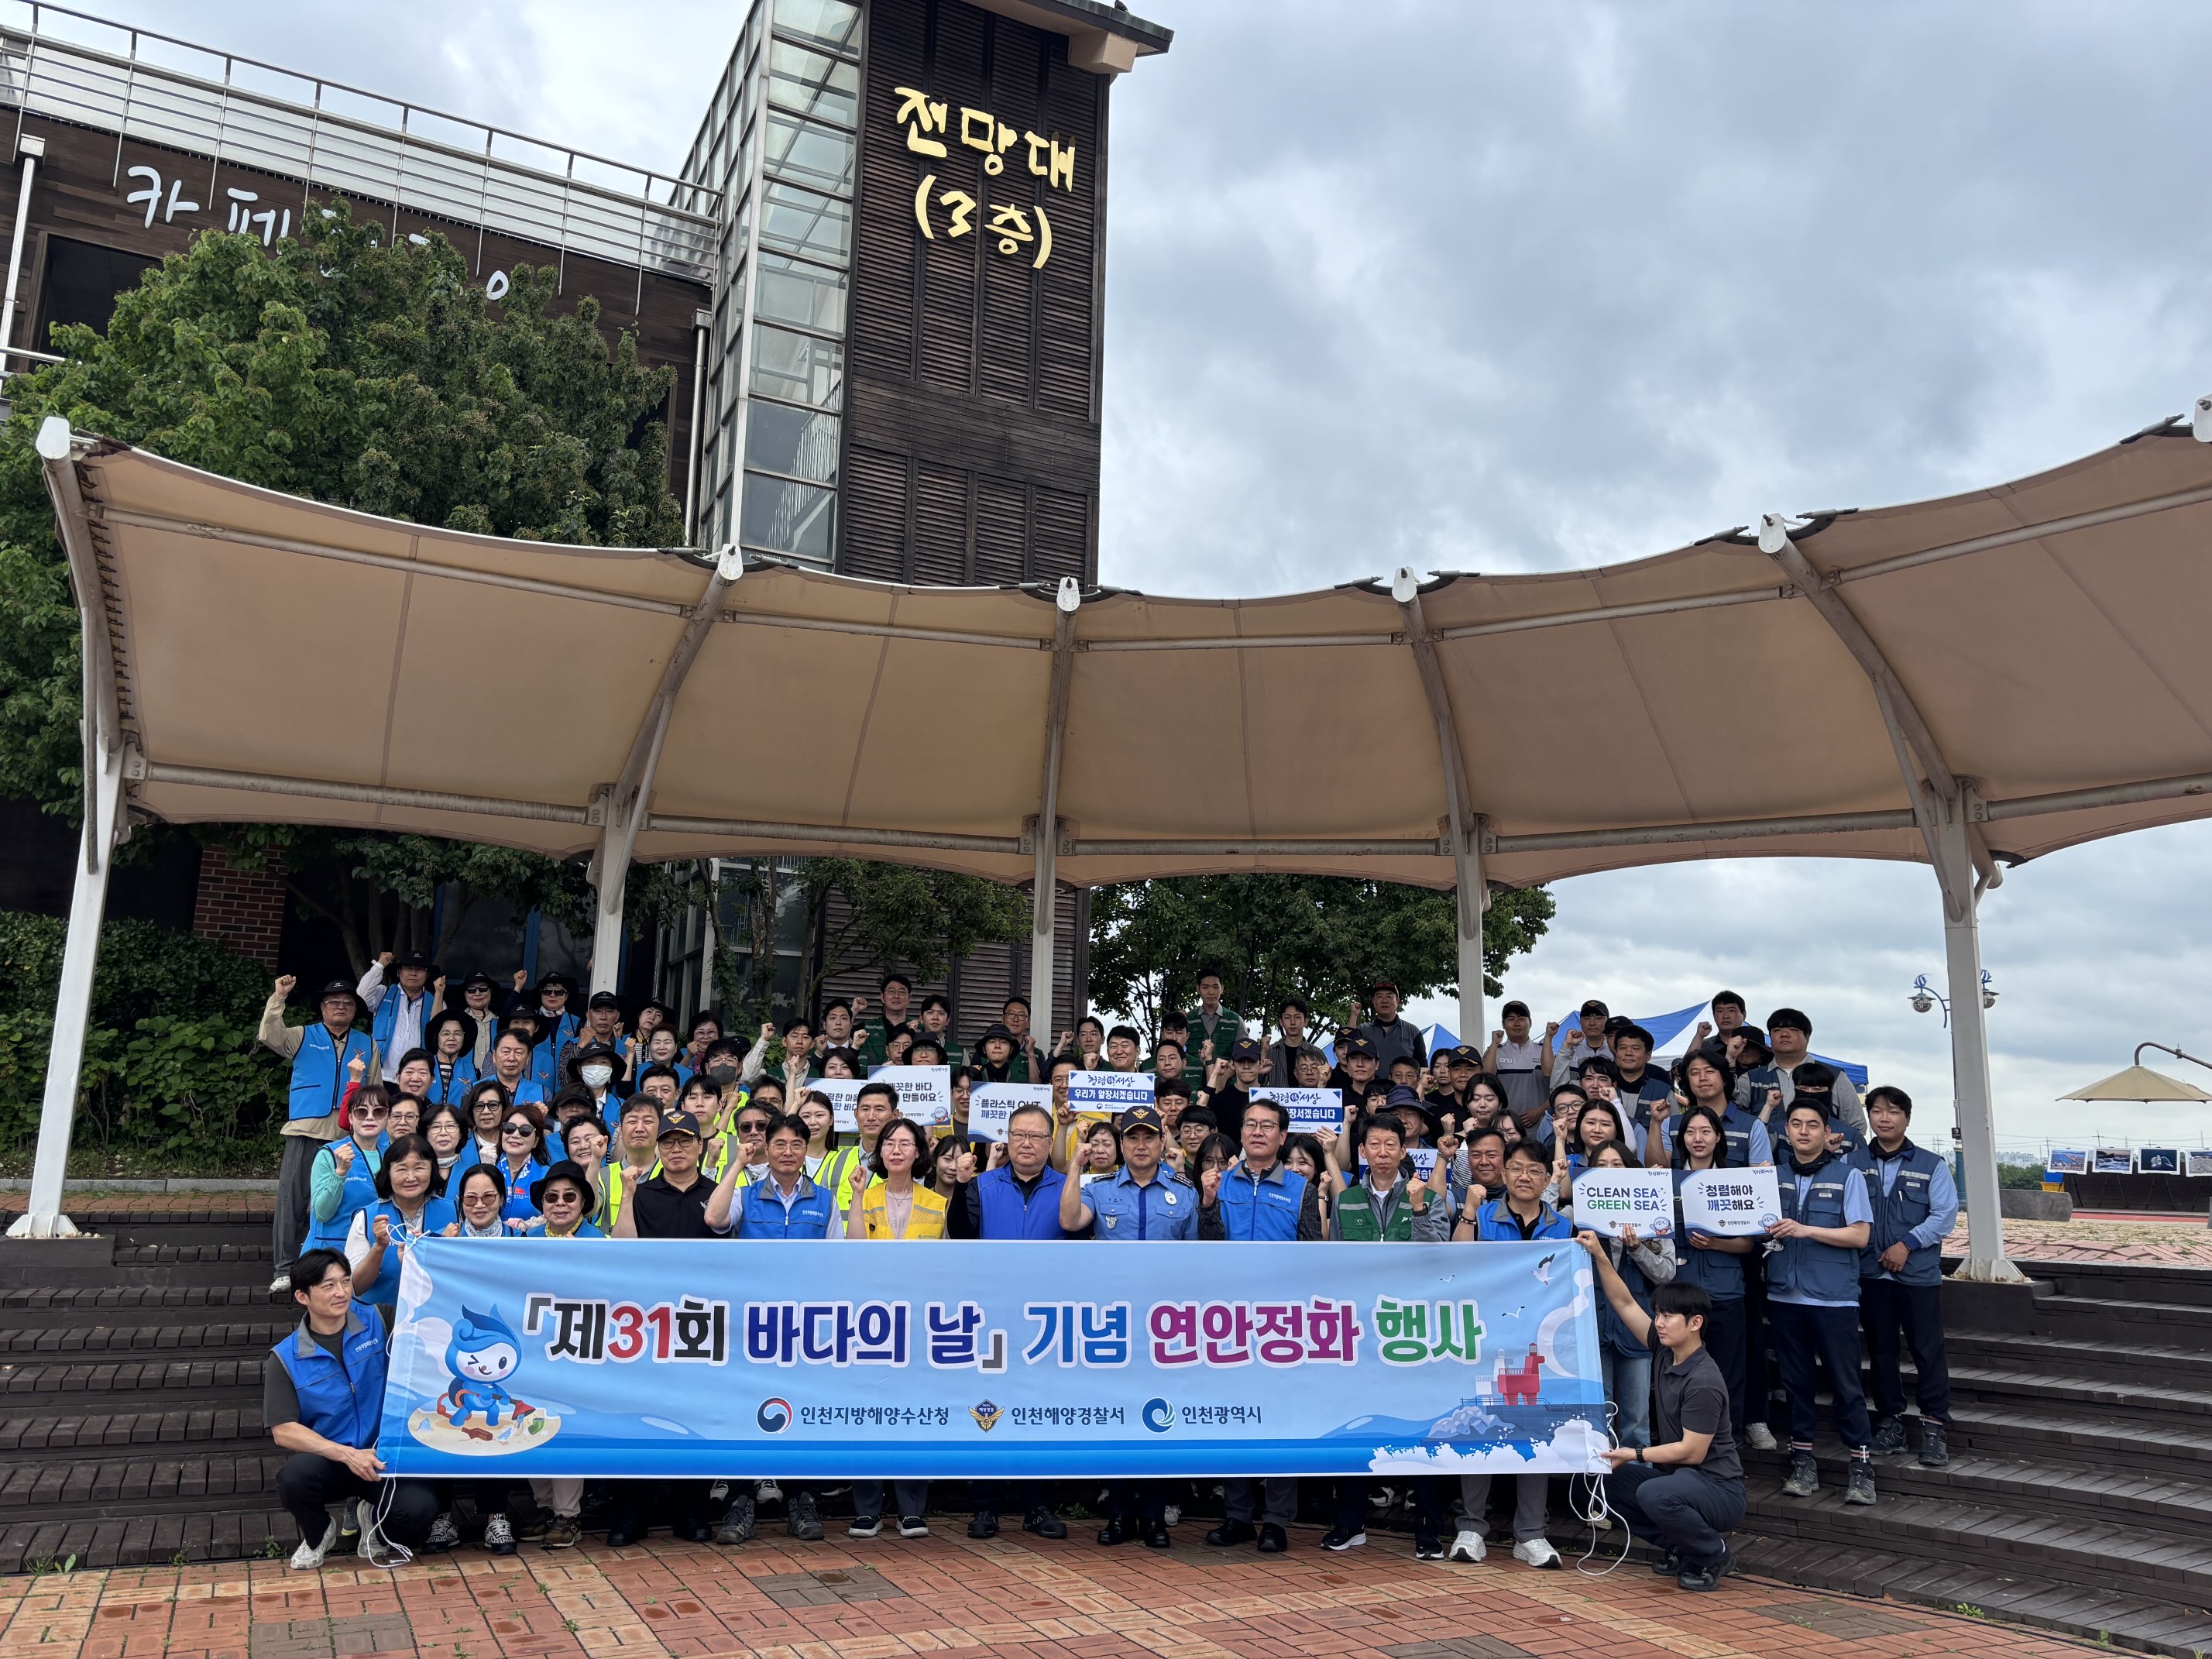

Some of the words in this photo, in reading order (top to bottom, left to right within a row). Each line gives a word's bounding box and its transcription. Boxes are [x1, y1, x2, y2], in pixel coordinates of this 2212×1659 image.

[894, 87, 1076, 193] 전망대
[915, 173, 1053, 270] (3층)
[915, 1082, 933, 1091] 바다
[825, 1092, 843, 1101] 렴한
[902, 1093, 937, 1102] 만들어요
[1074, 1088, 1096, 1099] 우리가
[981, 1098, 1015, 1109] 플라스틱
[981, 1109, 1007, 1119] 깨끗한
[1286, 1108, 1336, 1120] 장서겠습니다
[1586, 1187, 1630, 1198] CLEAN
[1633, 1187, 1659, 1198] SEA
[1705, 1184, 1753, 1197] 청렴해야
[1587, 1199, 1631, 1210] GREEN
[1633, 1200, 1660, 1211] SEA
[1707, 1199, 1755, 1211] 깨끗해요
[526, 1296, 726, 1363] 「제31회
[747, 1304, 907, 1364] 바다의
[929, 1304, 1003, 1369] 날」
[1026, 1304, 1128, 1364] 기념
[1149, 1300, 1361, 1364] 연안정화
[1375, 1299, 1482, 1362] 행사
[800, 1406, 950, 1426] 인천지방해양수산청
[1011, 1407, 1125, 1426] 인천해양경찰서
[1181, 1406, 1262, 1424] 인천광역시
